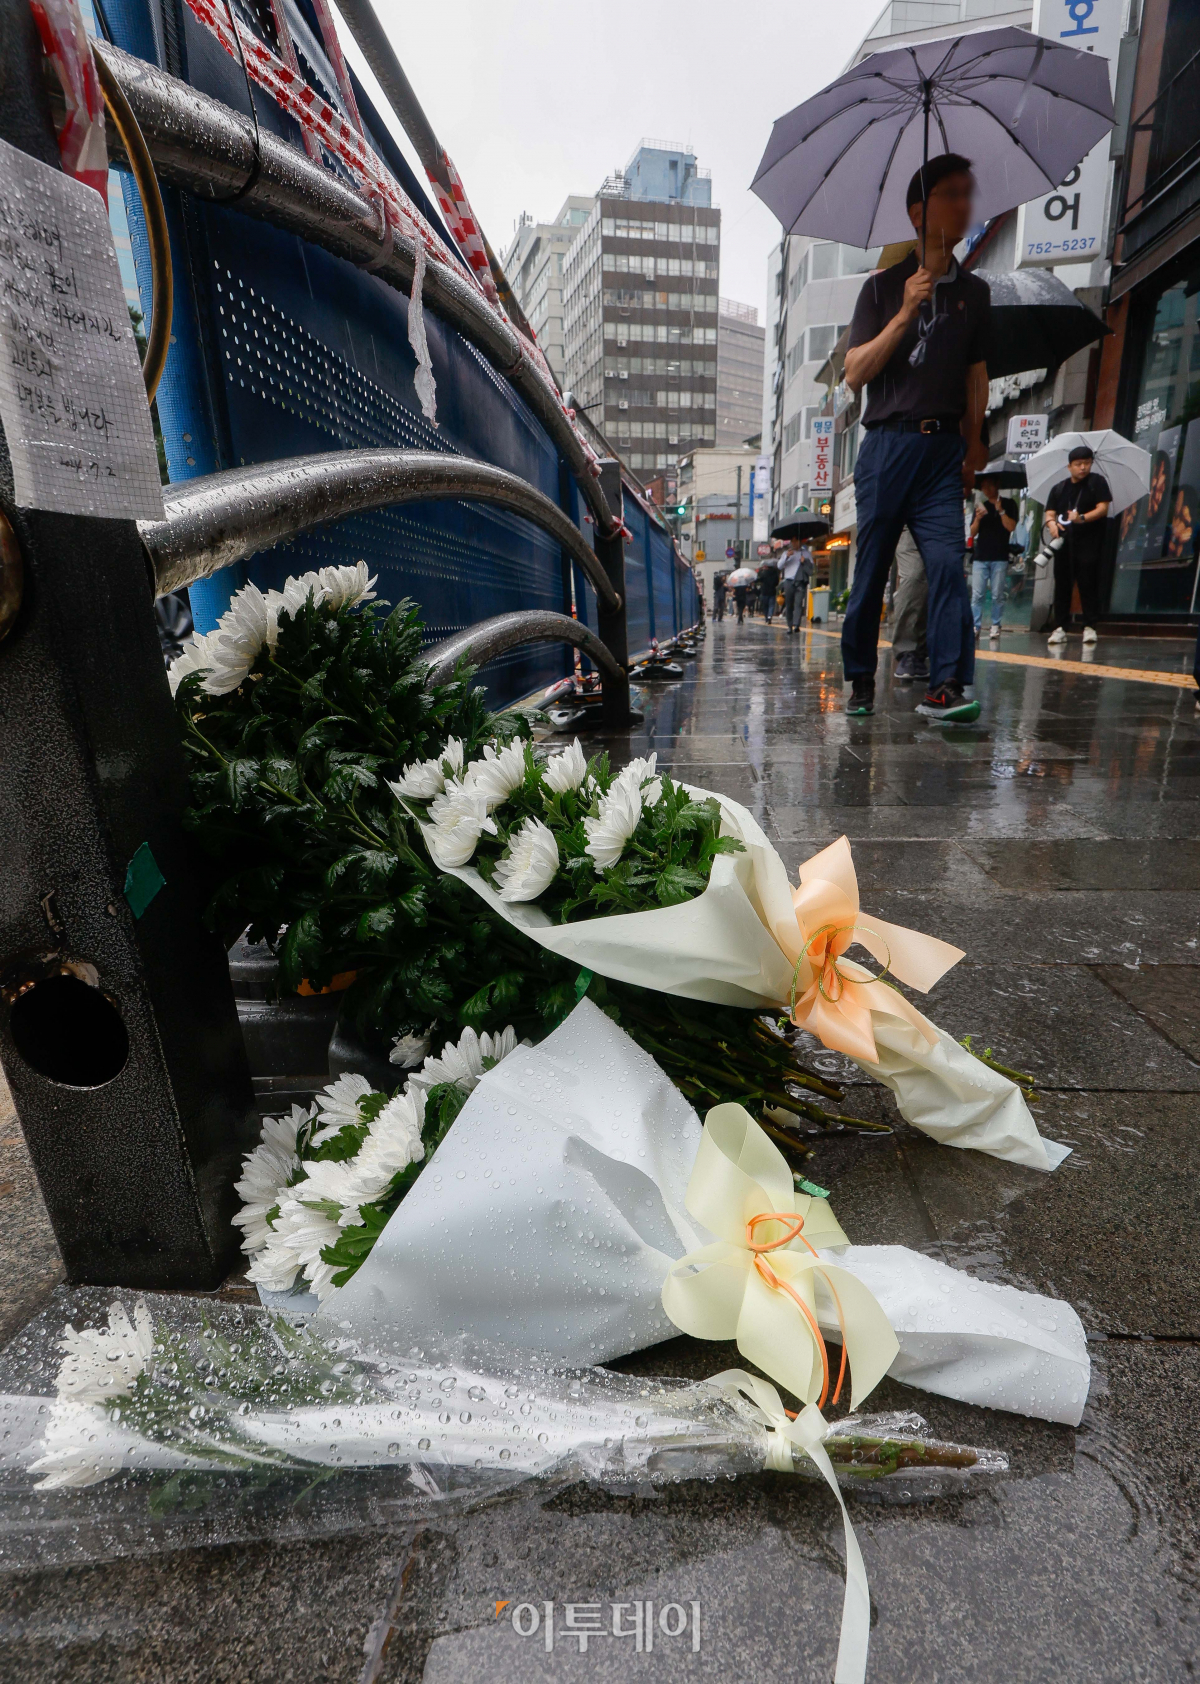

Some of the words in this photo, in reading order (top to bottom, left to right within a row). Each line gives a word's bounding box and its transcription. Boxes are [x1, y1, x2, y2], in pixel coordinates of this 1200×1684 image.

[1027, 237, 1096, 255] 752-5237
[814, 421, 832, 434] 명문
[814, 437, 830, 487] 부동산
